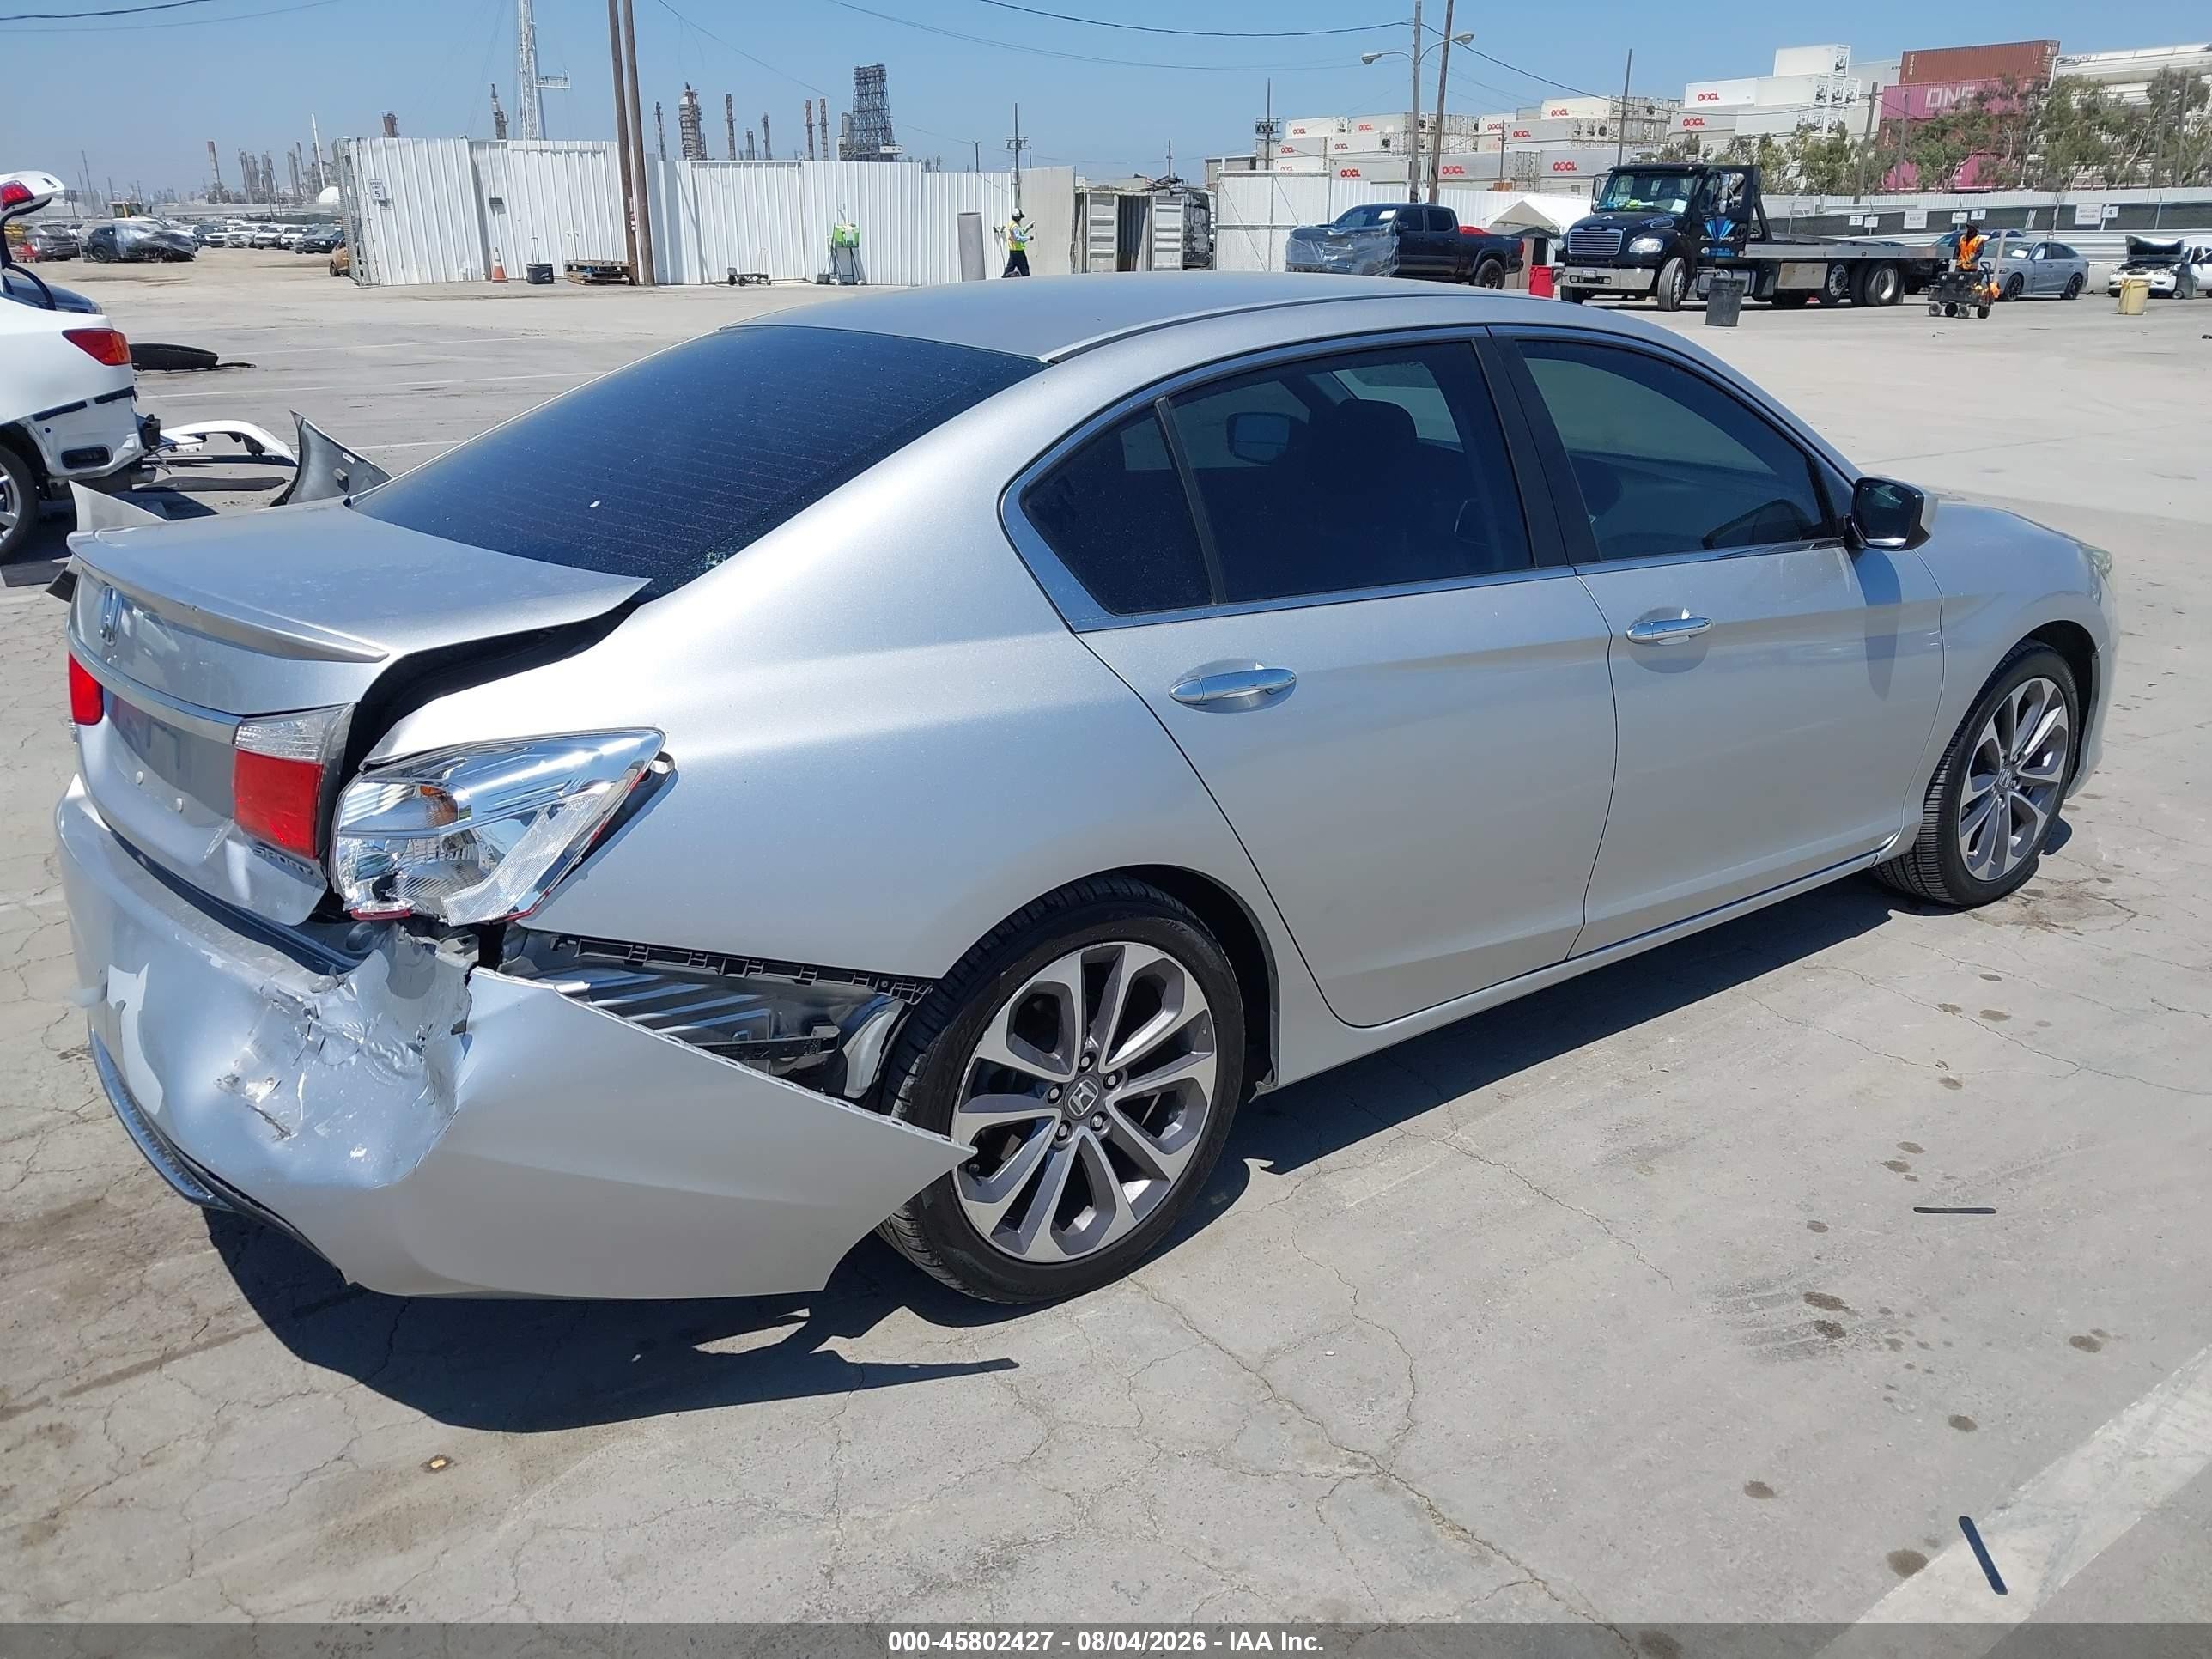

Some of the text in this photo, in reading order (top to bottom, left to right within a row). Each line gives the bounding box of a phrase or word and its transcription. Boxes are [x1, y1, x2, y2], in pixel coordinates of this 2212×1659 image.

[1698, 93, 1719, 101] OOCL
[1683, 118, 1705, 126] OOCL
[1442, 166, 1464, 174] OOCL
[1553, 161, 1577, 171] OOCL
[1340, 169, 1361, 178] OOCL
